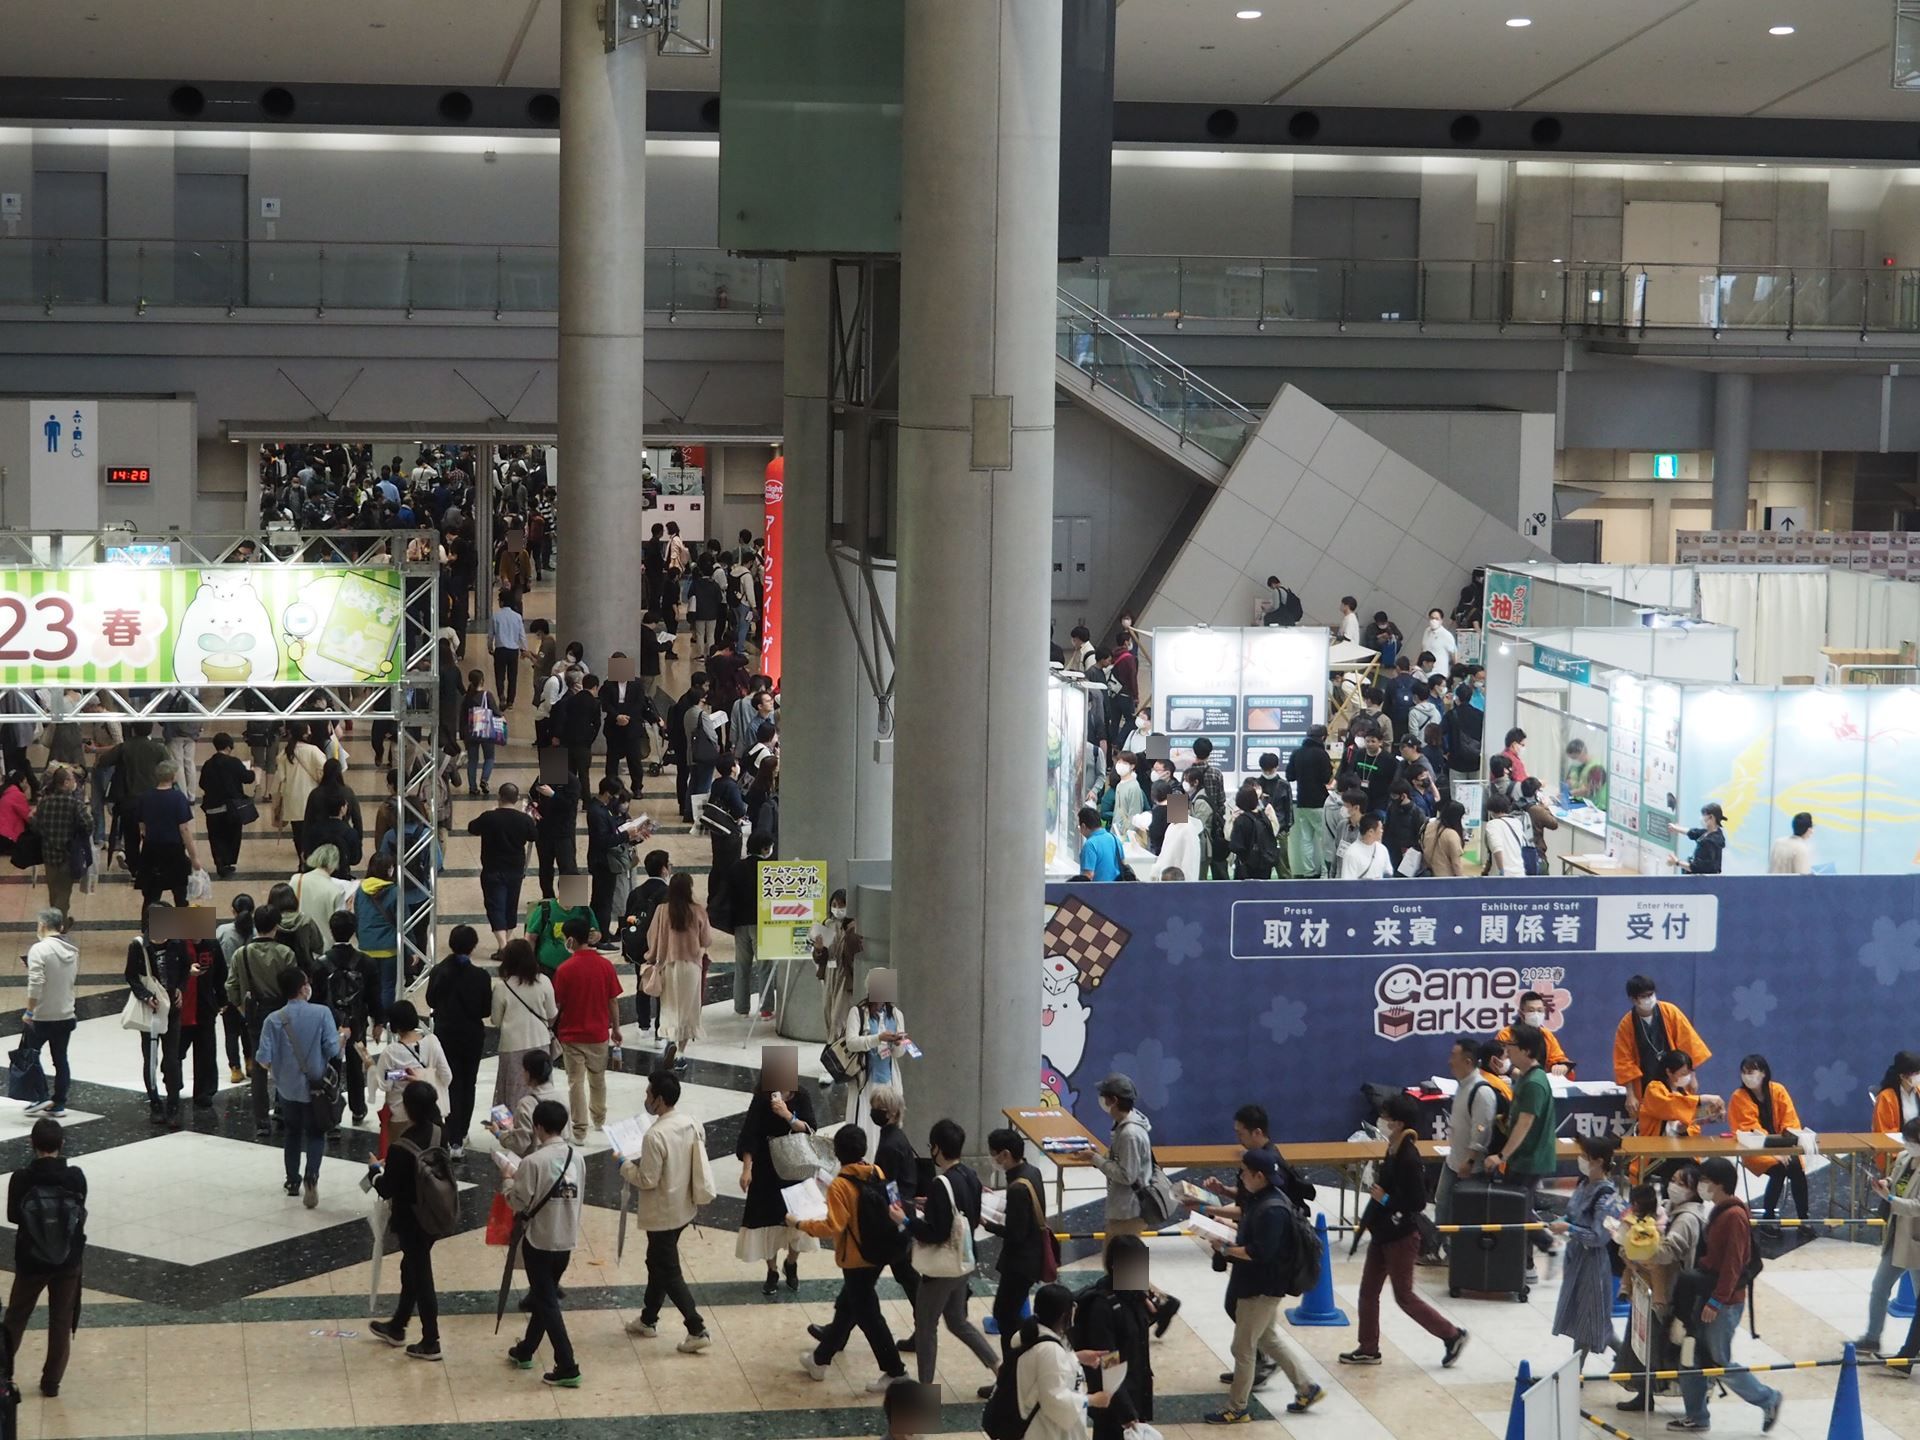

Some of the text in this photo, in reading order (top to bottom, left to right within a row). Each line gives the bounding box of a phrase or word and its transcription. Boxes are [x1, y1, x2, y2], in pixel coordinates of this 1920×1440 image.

[112, 470, 148, 481] 14:28
[0, 597, 141, 662] 23 春
[763, 876, 818, 886] スペシャル
[763, 887, 807, 898] ステージ
[1284, 906, 1313, 915] Press
[1392, 905, 1422, 913] Guest
[1481, 902, 1580, 911] Exhibitor and Staff
[1637, 901, 1684, 910] Enter Here
[1626, 912, 1690, 941] 受付
[1522, 968, 1563, 981] 2023春
[1379, 967, 1516, 1005] Game
